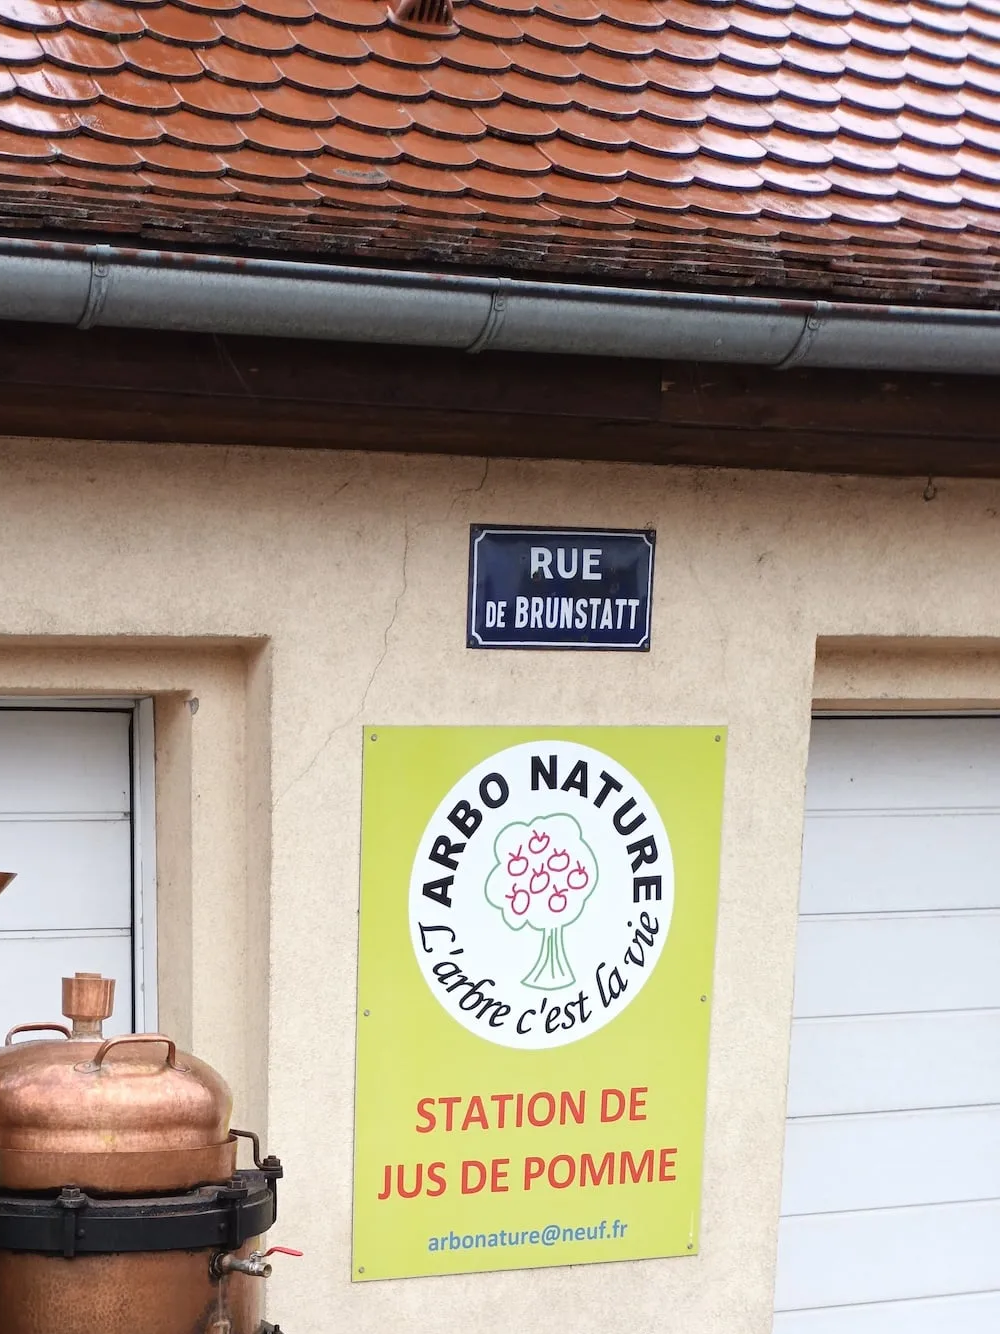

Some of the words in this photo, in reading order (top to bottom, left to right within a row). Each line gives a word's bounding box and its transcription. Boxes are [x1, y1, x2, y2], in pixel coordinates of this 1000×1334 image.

[531, 547, 602, 580] RUE
[486, 601, 507, 628] DE
[515, 596, 639, 629] BRUNSTATT
[422, 772, 509, 908] ARBO
[531, 755, 662, 903] NATURE
[418, 921, 511, 1027] L'arbre
[517, 990, 592, 1034] c'est
[596, 962, 628, 1008] la
[624, 911, 659, 967] vie
[415, 1090, 586, 1133] STATION
[600, 1087, 648, 1122] DE
[378, 1162, 447, 1200] JUS
[461, 1158, 510, 1194] DE
[523, 1148, 678, 1191] POMME
[428, 1219, 628, 1251] arbonature@neuf.fr
